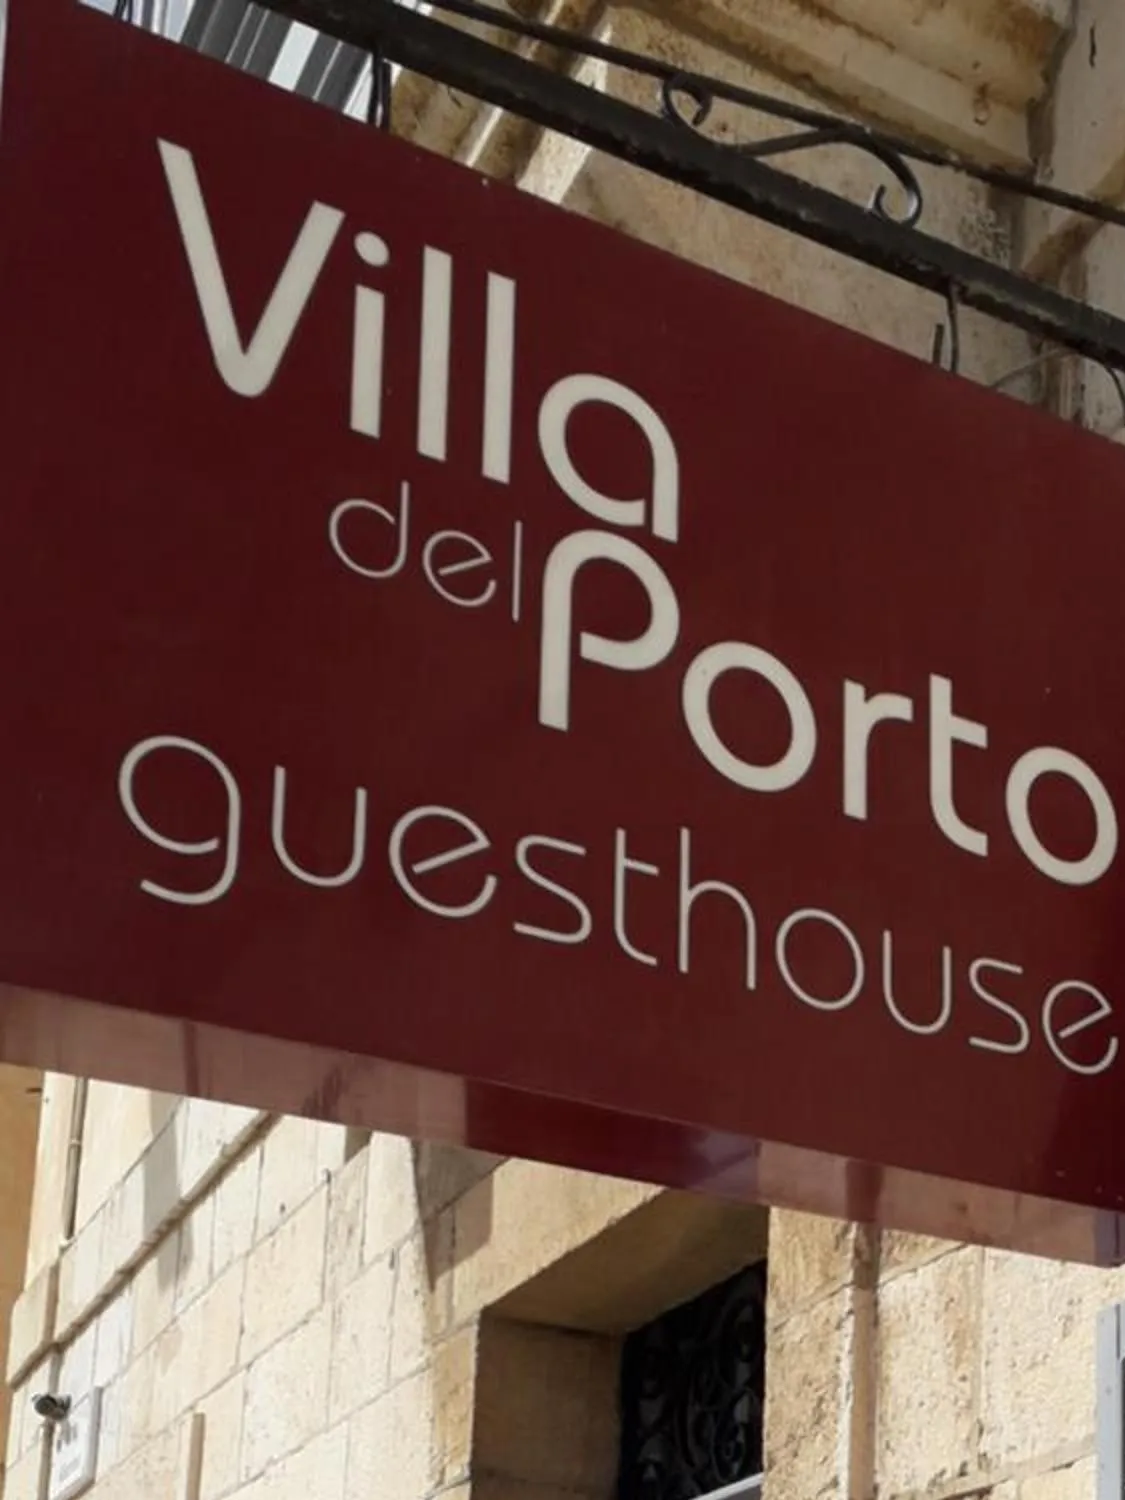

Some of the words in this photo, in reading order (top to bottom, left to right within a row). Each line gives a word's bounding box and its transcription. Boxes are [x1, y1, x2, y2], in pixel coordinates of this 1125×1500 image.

[158, 138, 679, 542] Villa
[329, 481, 523, 621] del
[539, 530, 1118, 885] Porto
[119, 736, 1118, 1075] guesthouse
